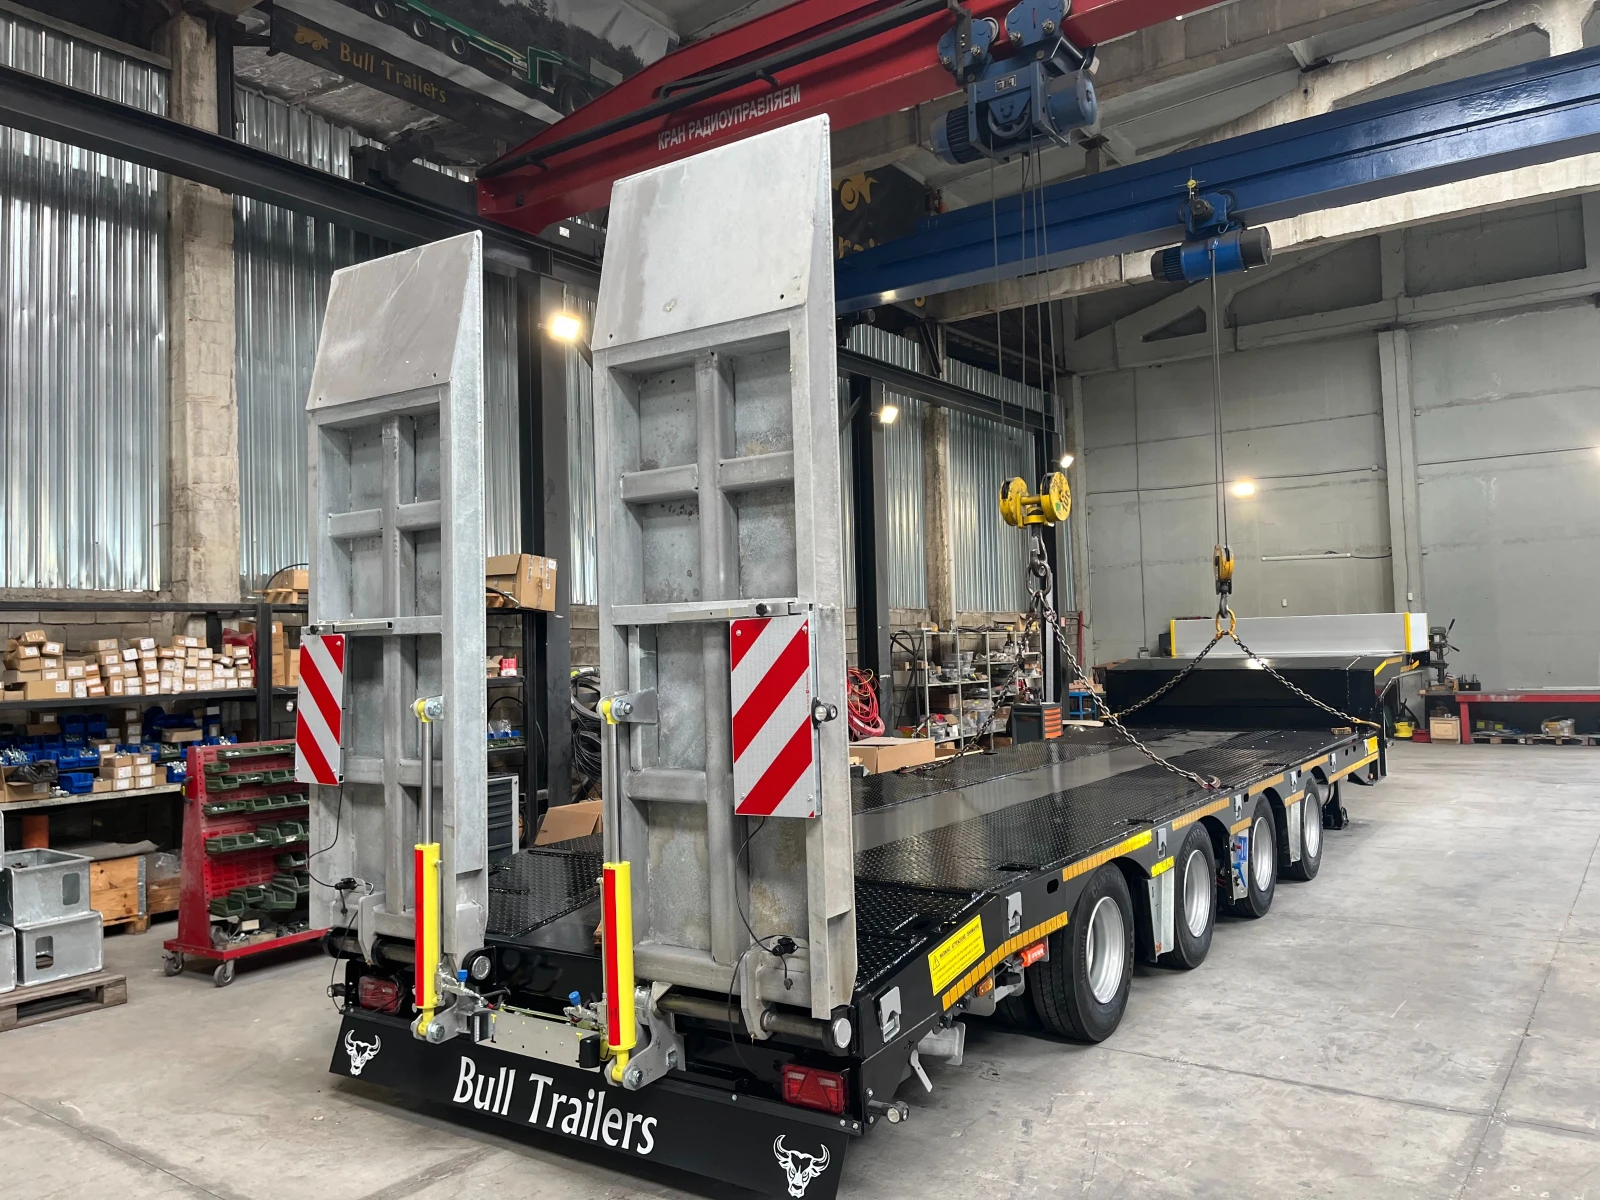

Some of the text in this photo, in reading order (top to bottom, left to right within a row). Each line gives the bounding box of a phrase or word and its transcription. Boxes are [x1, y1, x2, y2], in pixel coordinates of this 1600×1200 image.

[340, 41, 446, 103] Bull Trailers
[657, 83, 801, 151] КРАН РАДИОУПРАВЛЯЕМ
[452, 1055, 658, 1155] Bull Trailers
